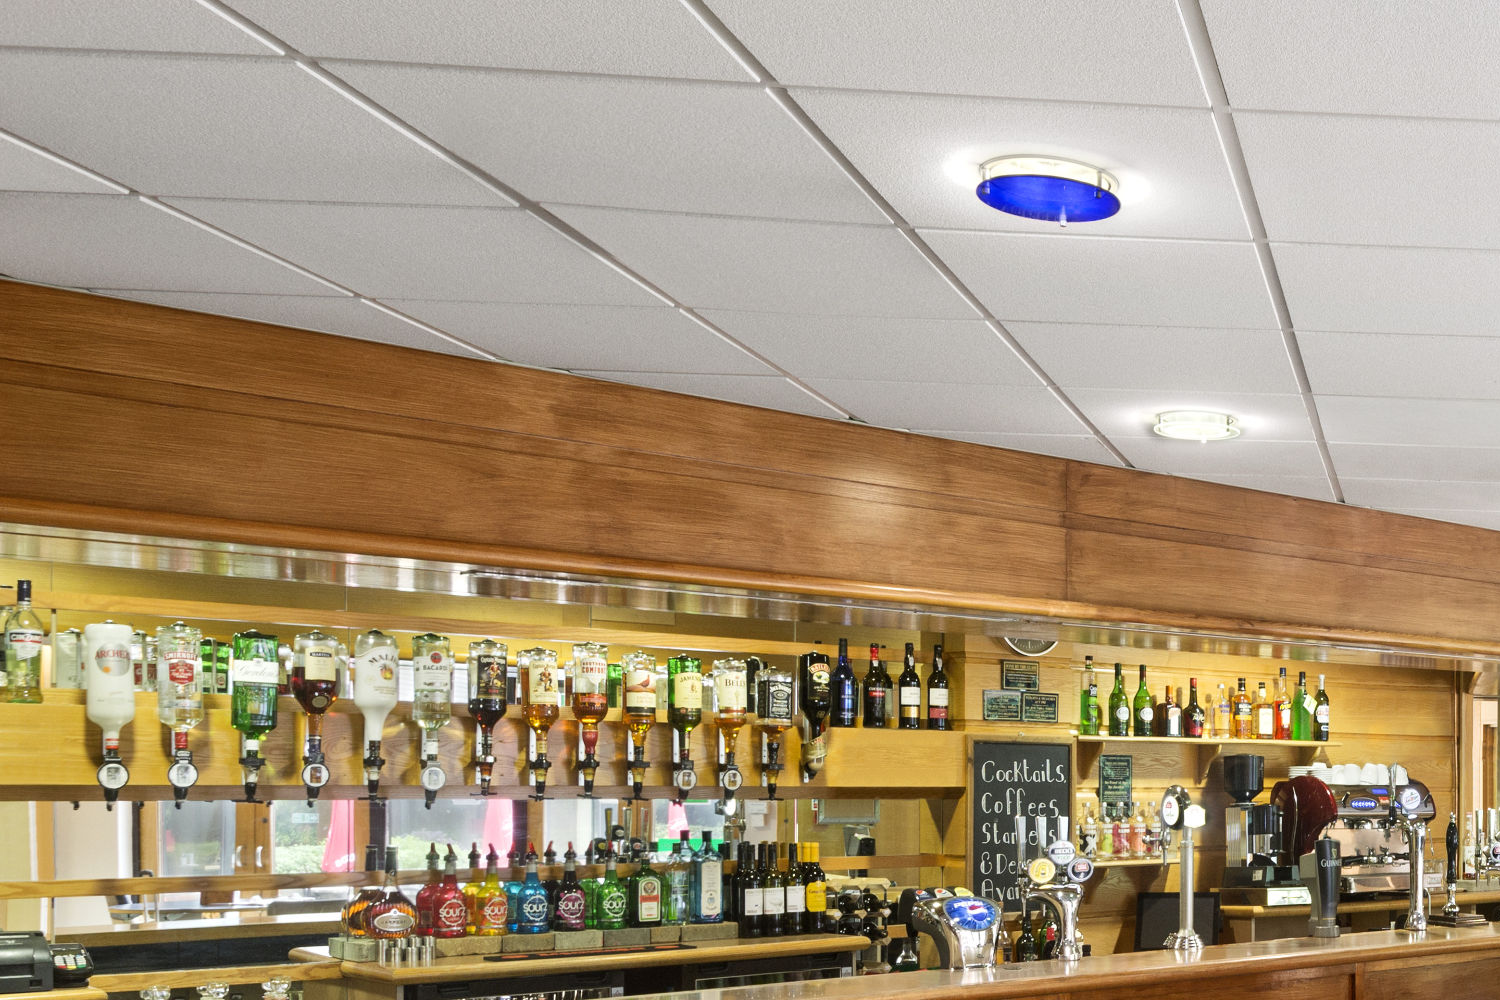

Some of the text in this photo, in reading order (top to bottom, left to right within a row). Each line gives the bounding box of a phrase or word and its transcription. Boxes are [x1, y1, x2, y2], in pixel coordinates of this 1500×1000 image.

[981, 758, 1067, 783] Cocktails,
[981, 822, 1057, 846] Stares
[980, 851, 993, 875] &
[953, 900, 984, 909] PEPSI
